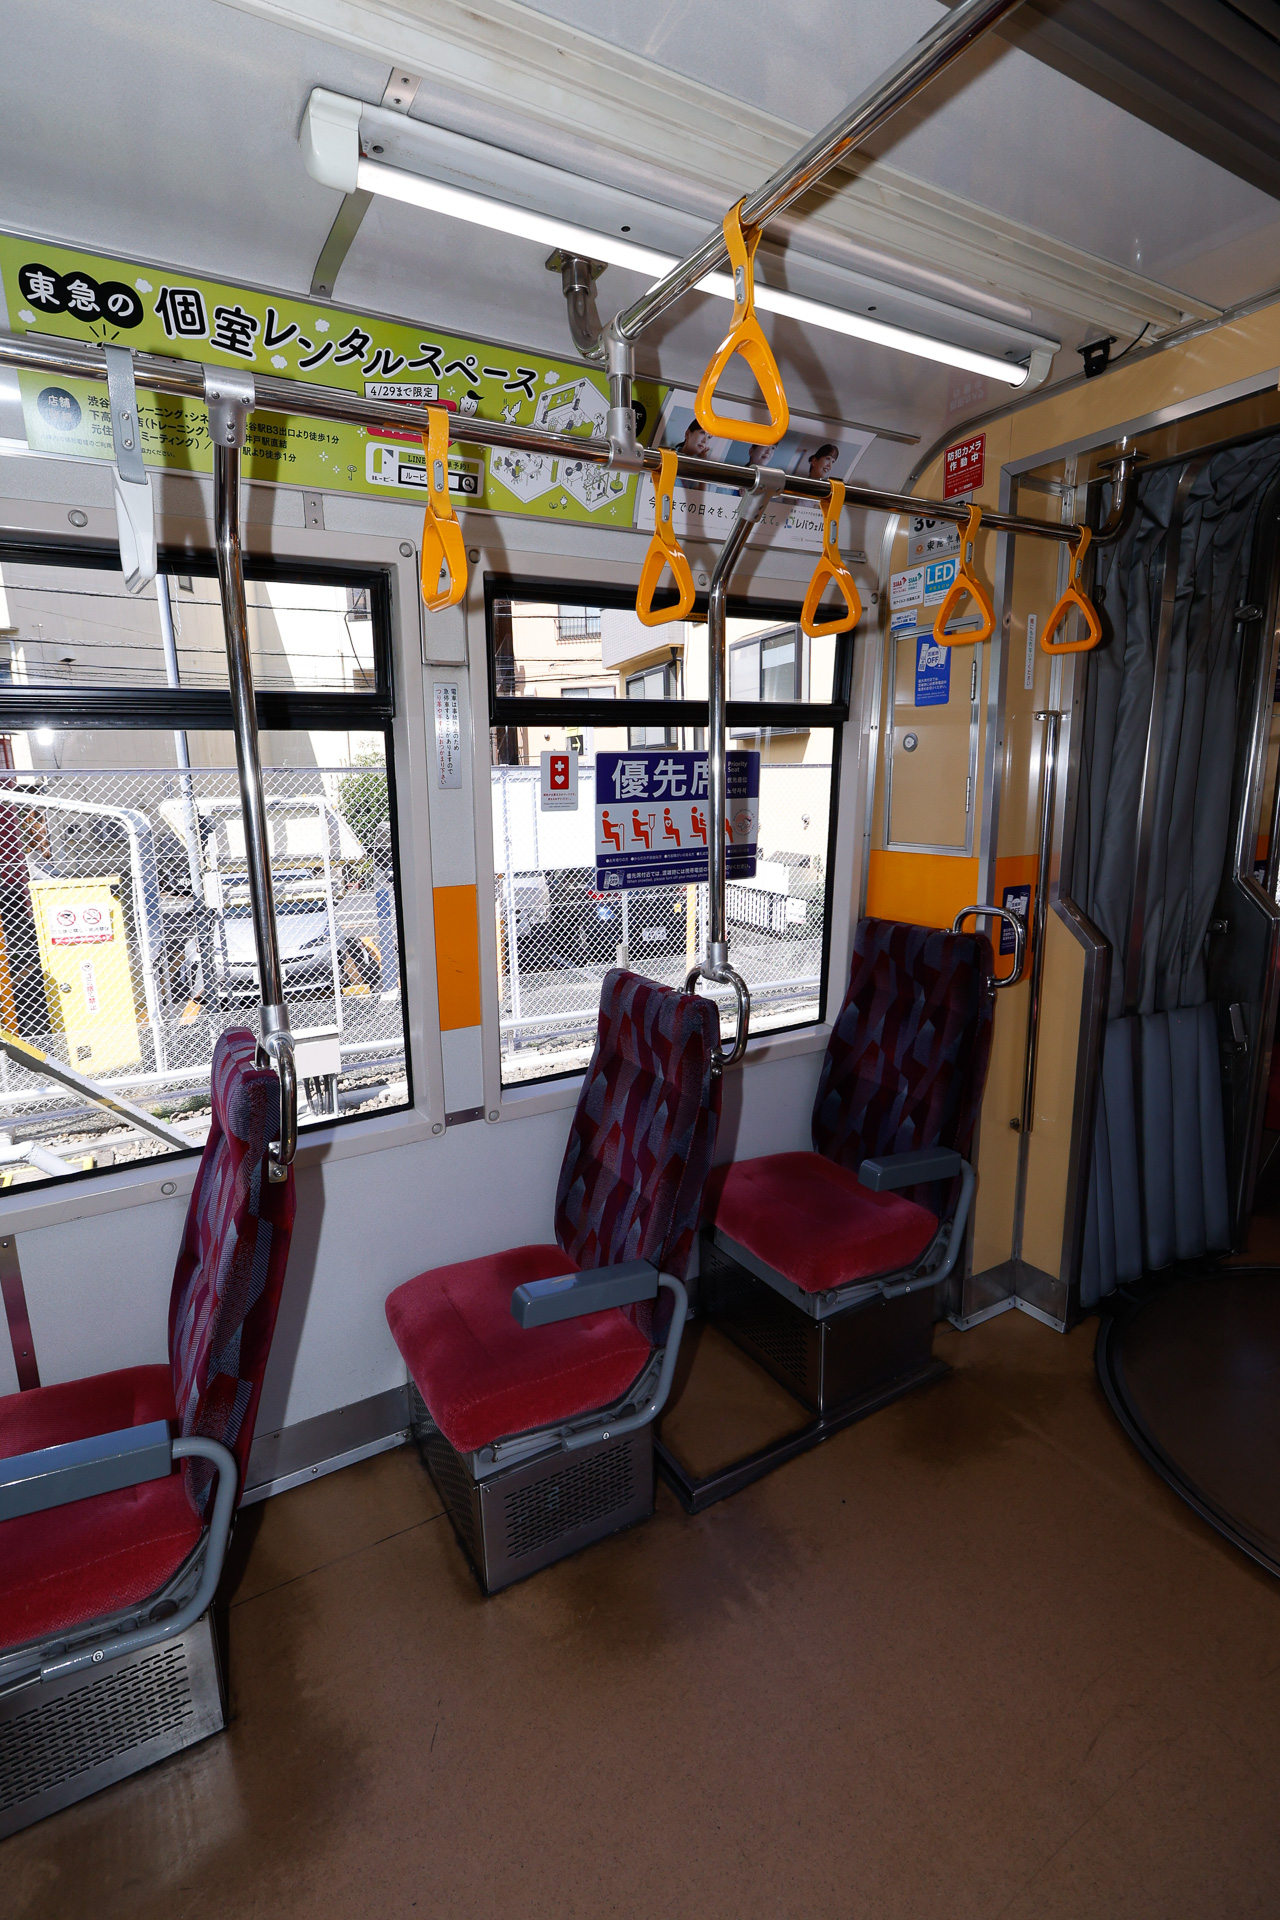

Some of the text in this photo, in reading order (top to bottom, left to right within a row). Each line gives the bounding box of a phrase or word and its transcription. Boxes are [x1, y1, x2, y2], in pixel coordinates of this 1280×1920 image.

[25, 271, 134, 317] 東急の
[154, 286, 539, 400] 個室レンタルスペース
[48, 394, 71, 408] 店舗
[370, 386, 433, 398] 4/29まで限定
[947, 440, 981, 462] 防犯カメラ
[926, 563, 954, 586] LED
[926, 656, 939, 664] OFF
